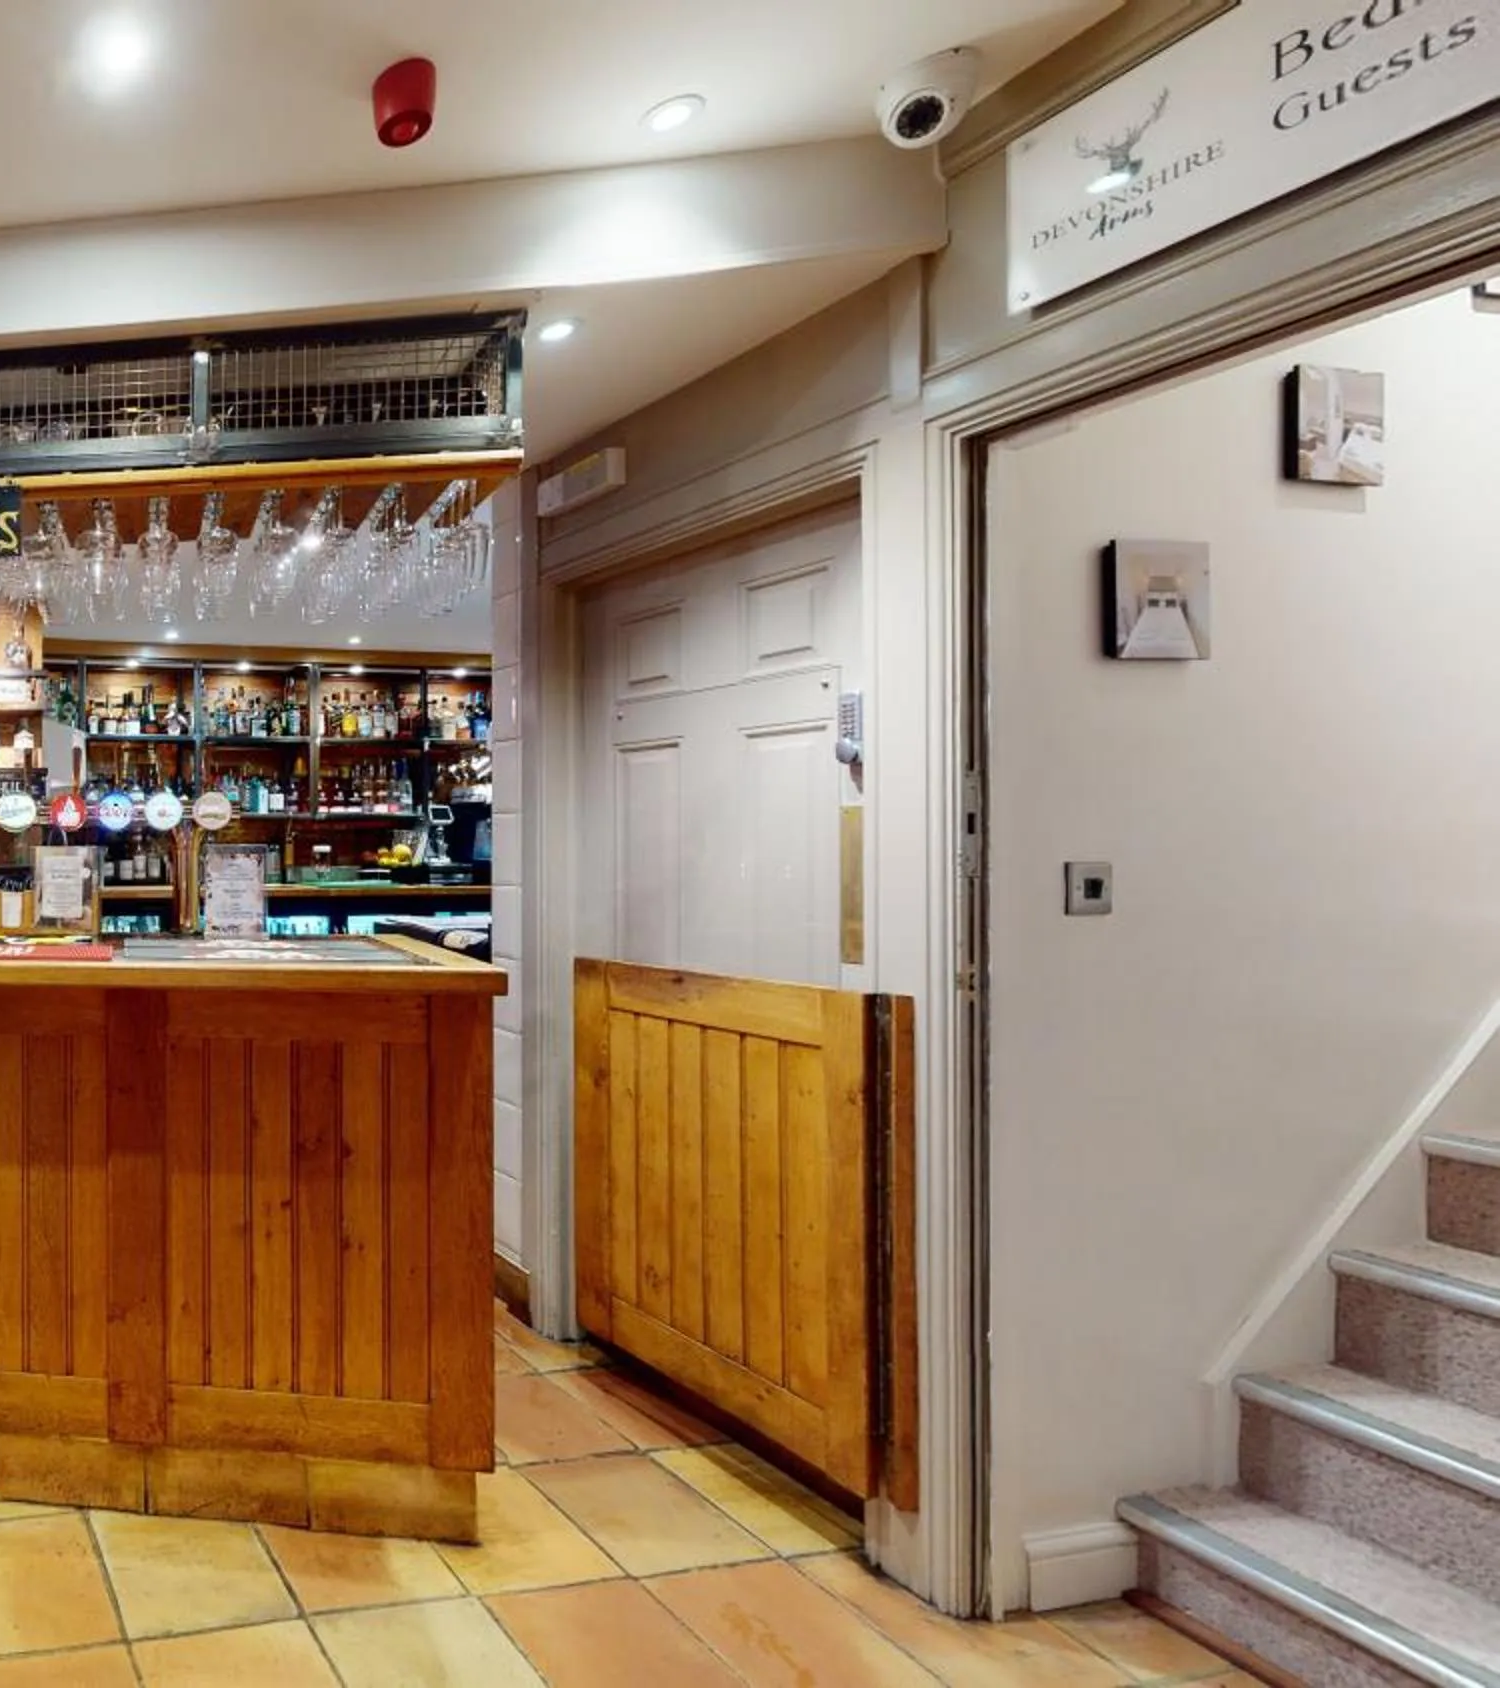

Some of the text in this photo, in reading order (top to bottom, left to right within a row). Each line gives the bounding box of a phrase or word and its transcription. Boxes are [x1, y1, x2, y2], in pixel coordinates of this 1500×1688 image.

[1273, 16, 1476, 130] Guests
[1030, 139, 1227, 250] DEVONSHIRE
[1088, 199, 1154, 241] Arms
